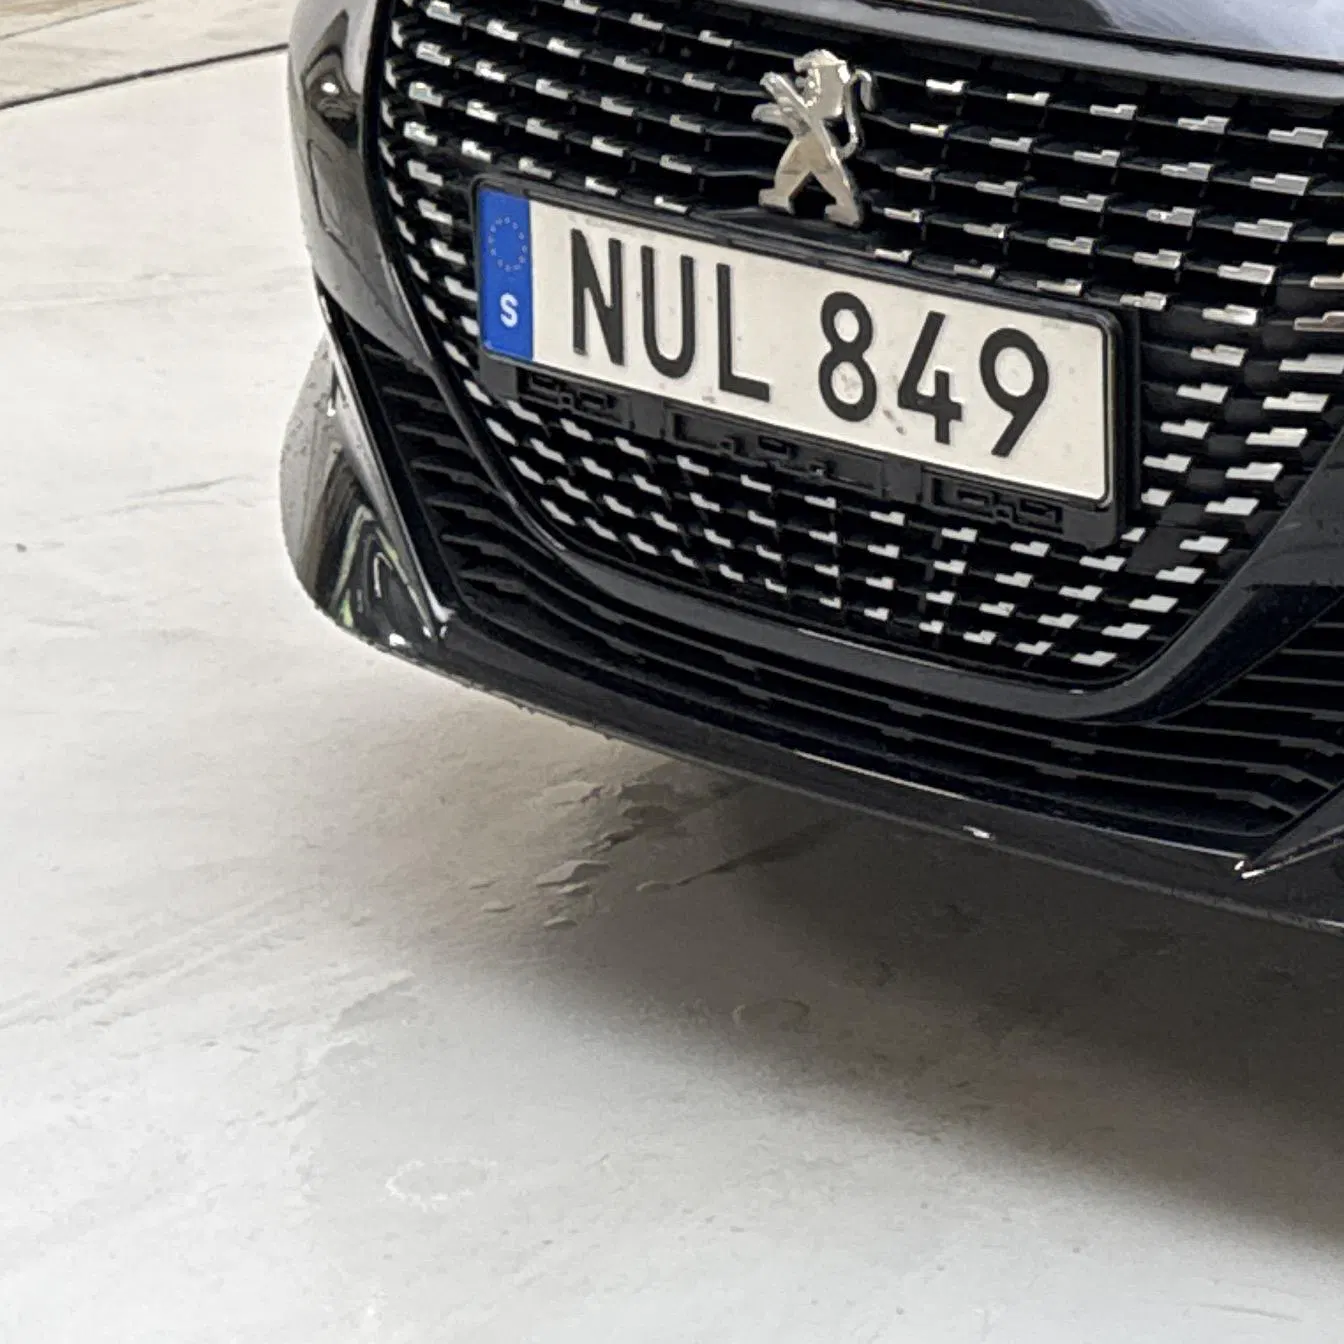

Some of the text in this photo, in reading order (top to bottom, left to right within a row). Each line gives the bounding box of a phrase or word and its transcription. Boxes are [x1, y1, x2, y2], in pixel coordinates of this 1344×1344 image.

[499, 292, 519, 328] S
[570, 228, 1050, 458] NUL 849
